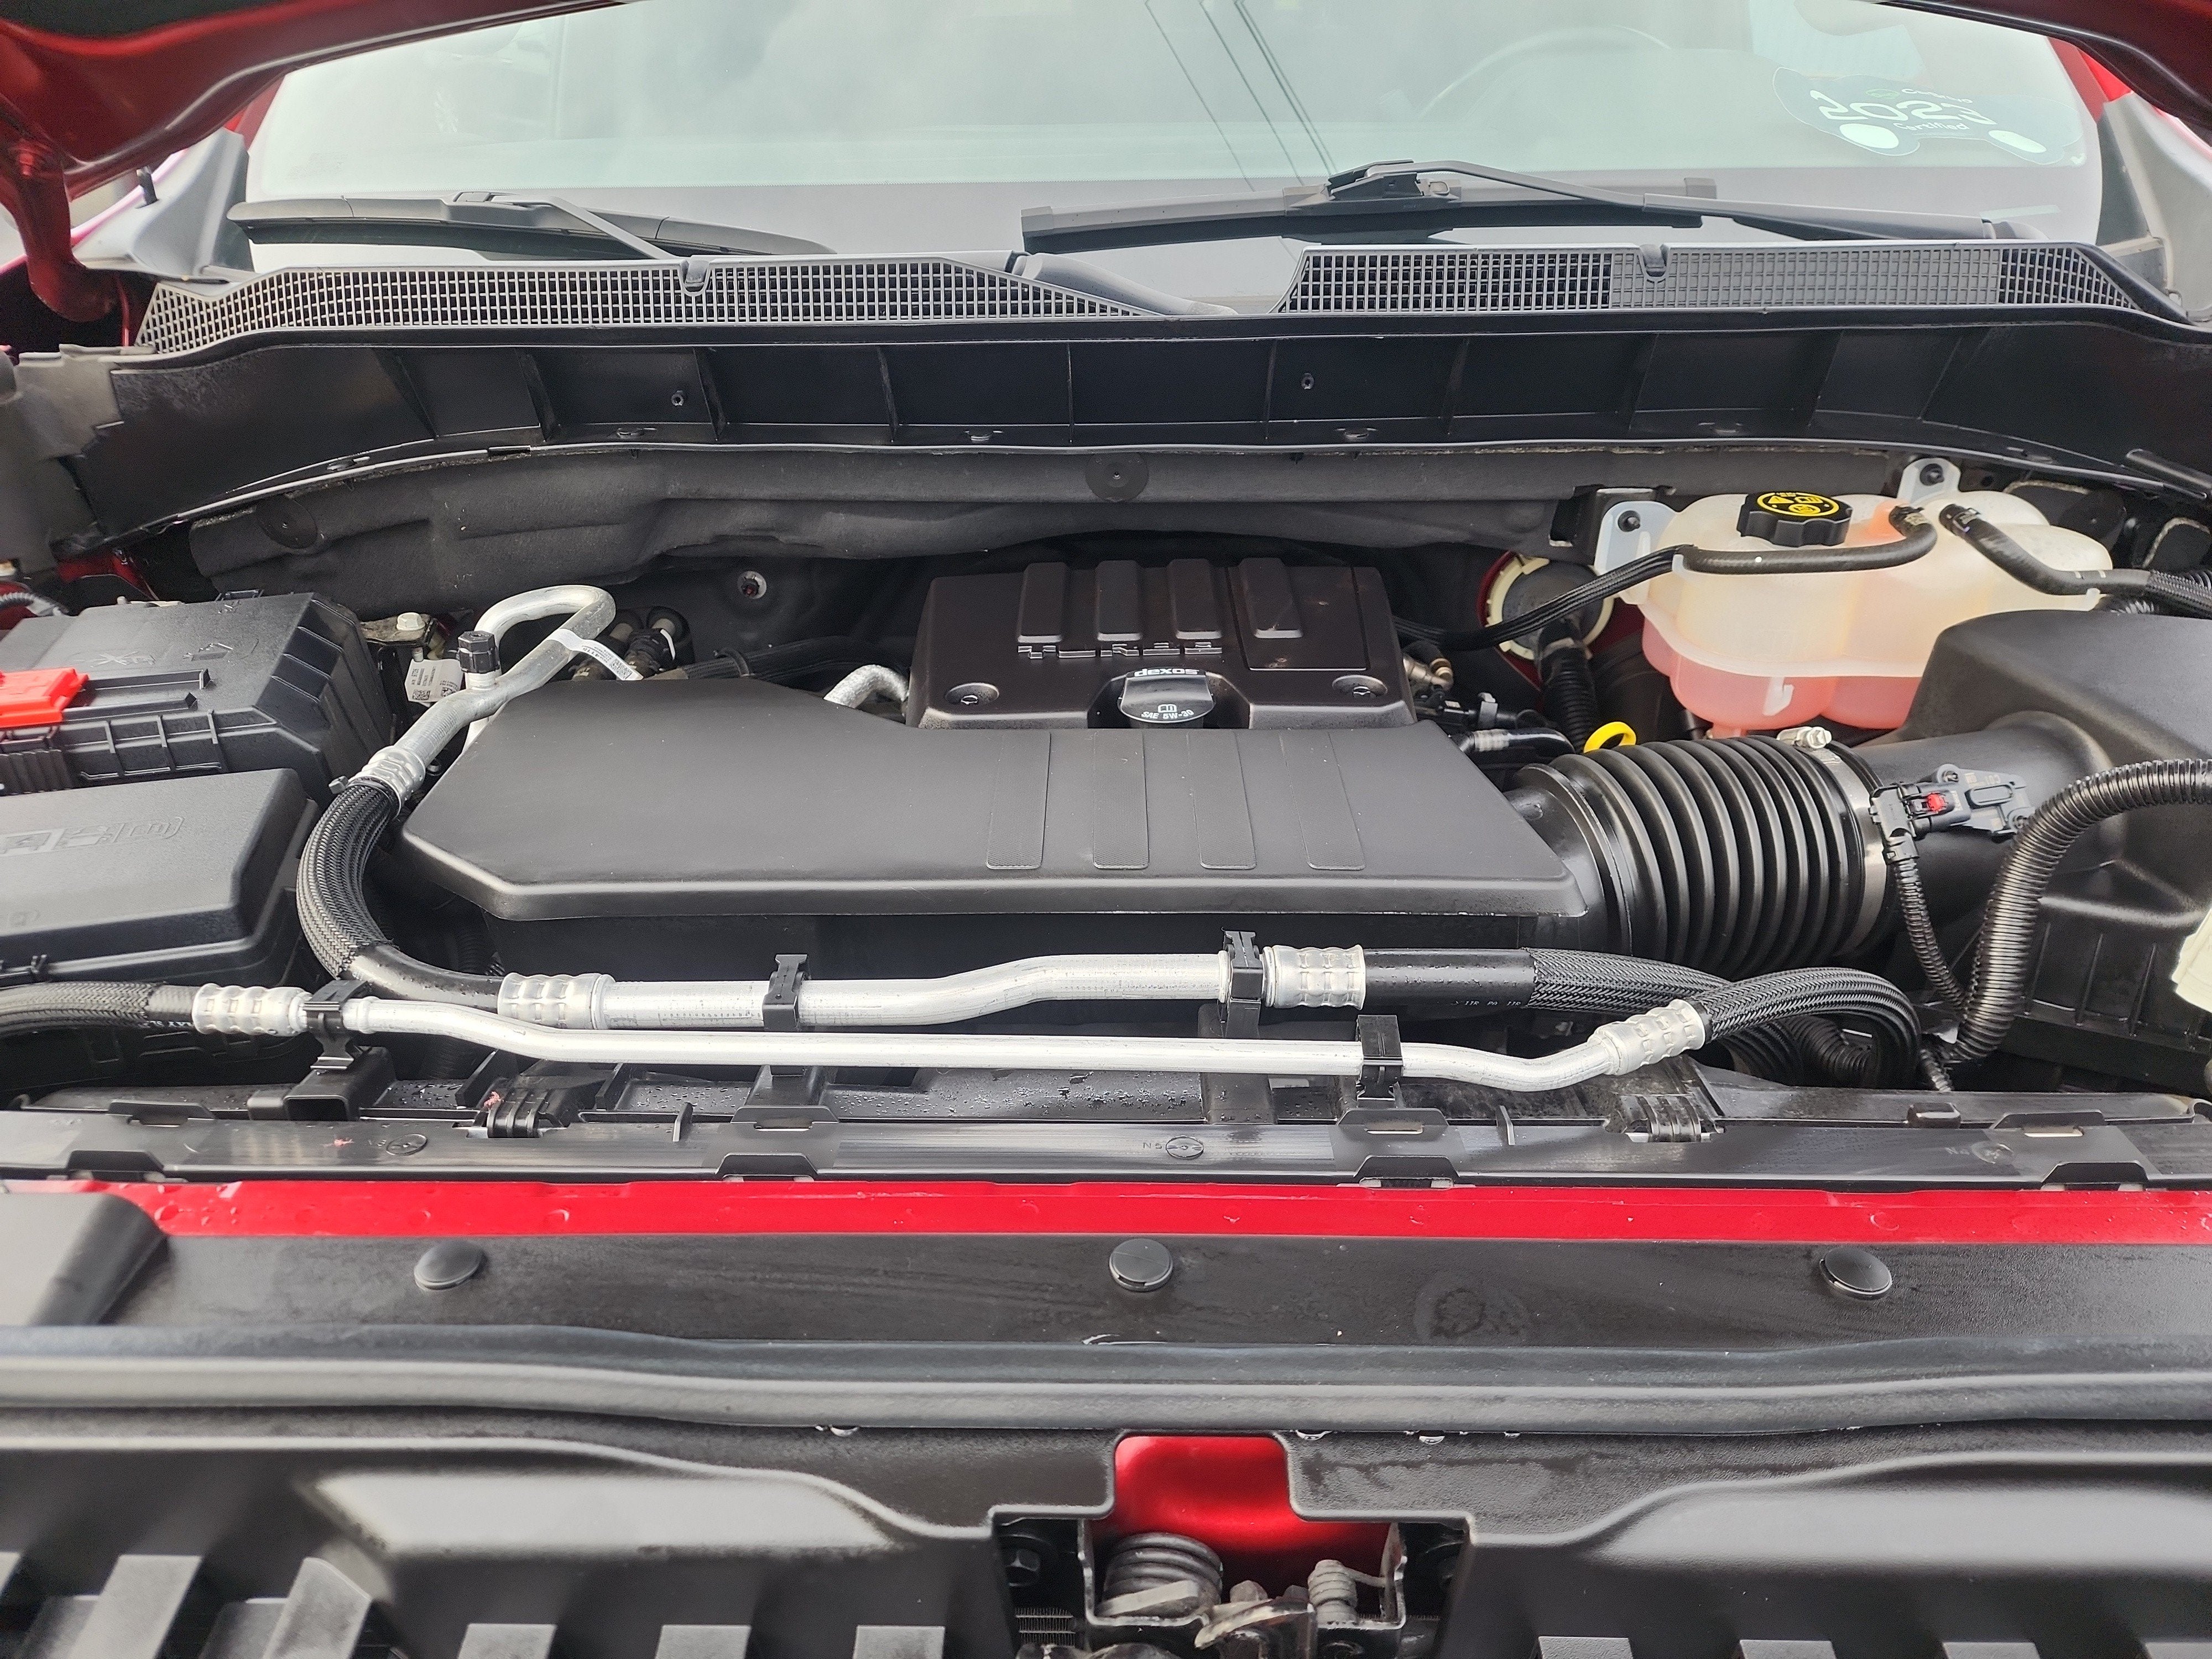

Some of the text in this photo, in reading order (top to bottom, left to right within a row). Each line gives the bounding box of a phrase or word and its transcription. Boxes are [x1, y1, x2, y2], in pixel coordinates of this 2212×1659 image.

[1810, 89, 1998, 125] 2023
[1134, 667, 1200, 677] dexos
[1141, 709, 1194, 719] SAE 5W-30
